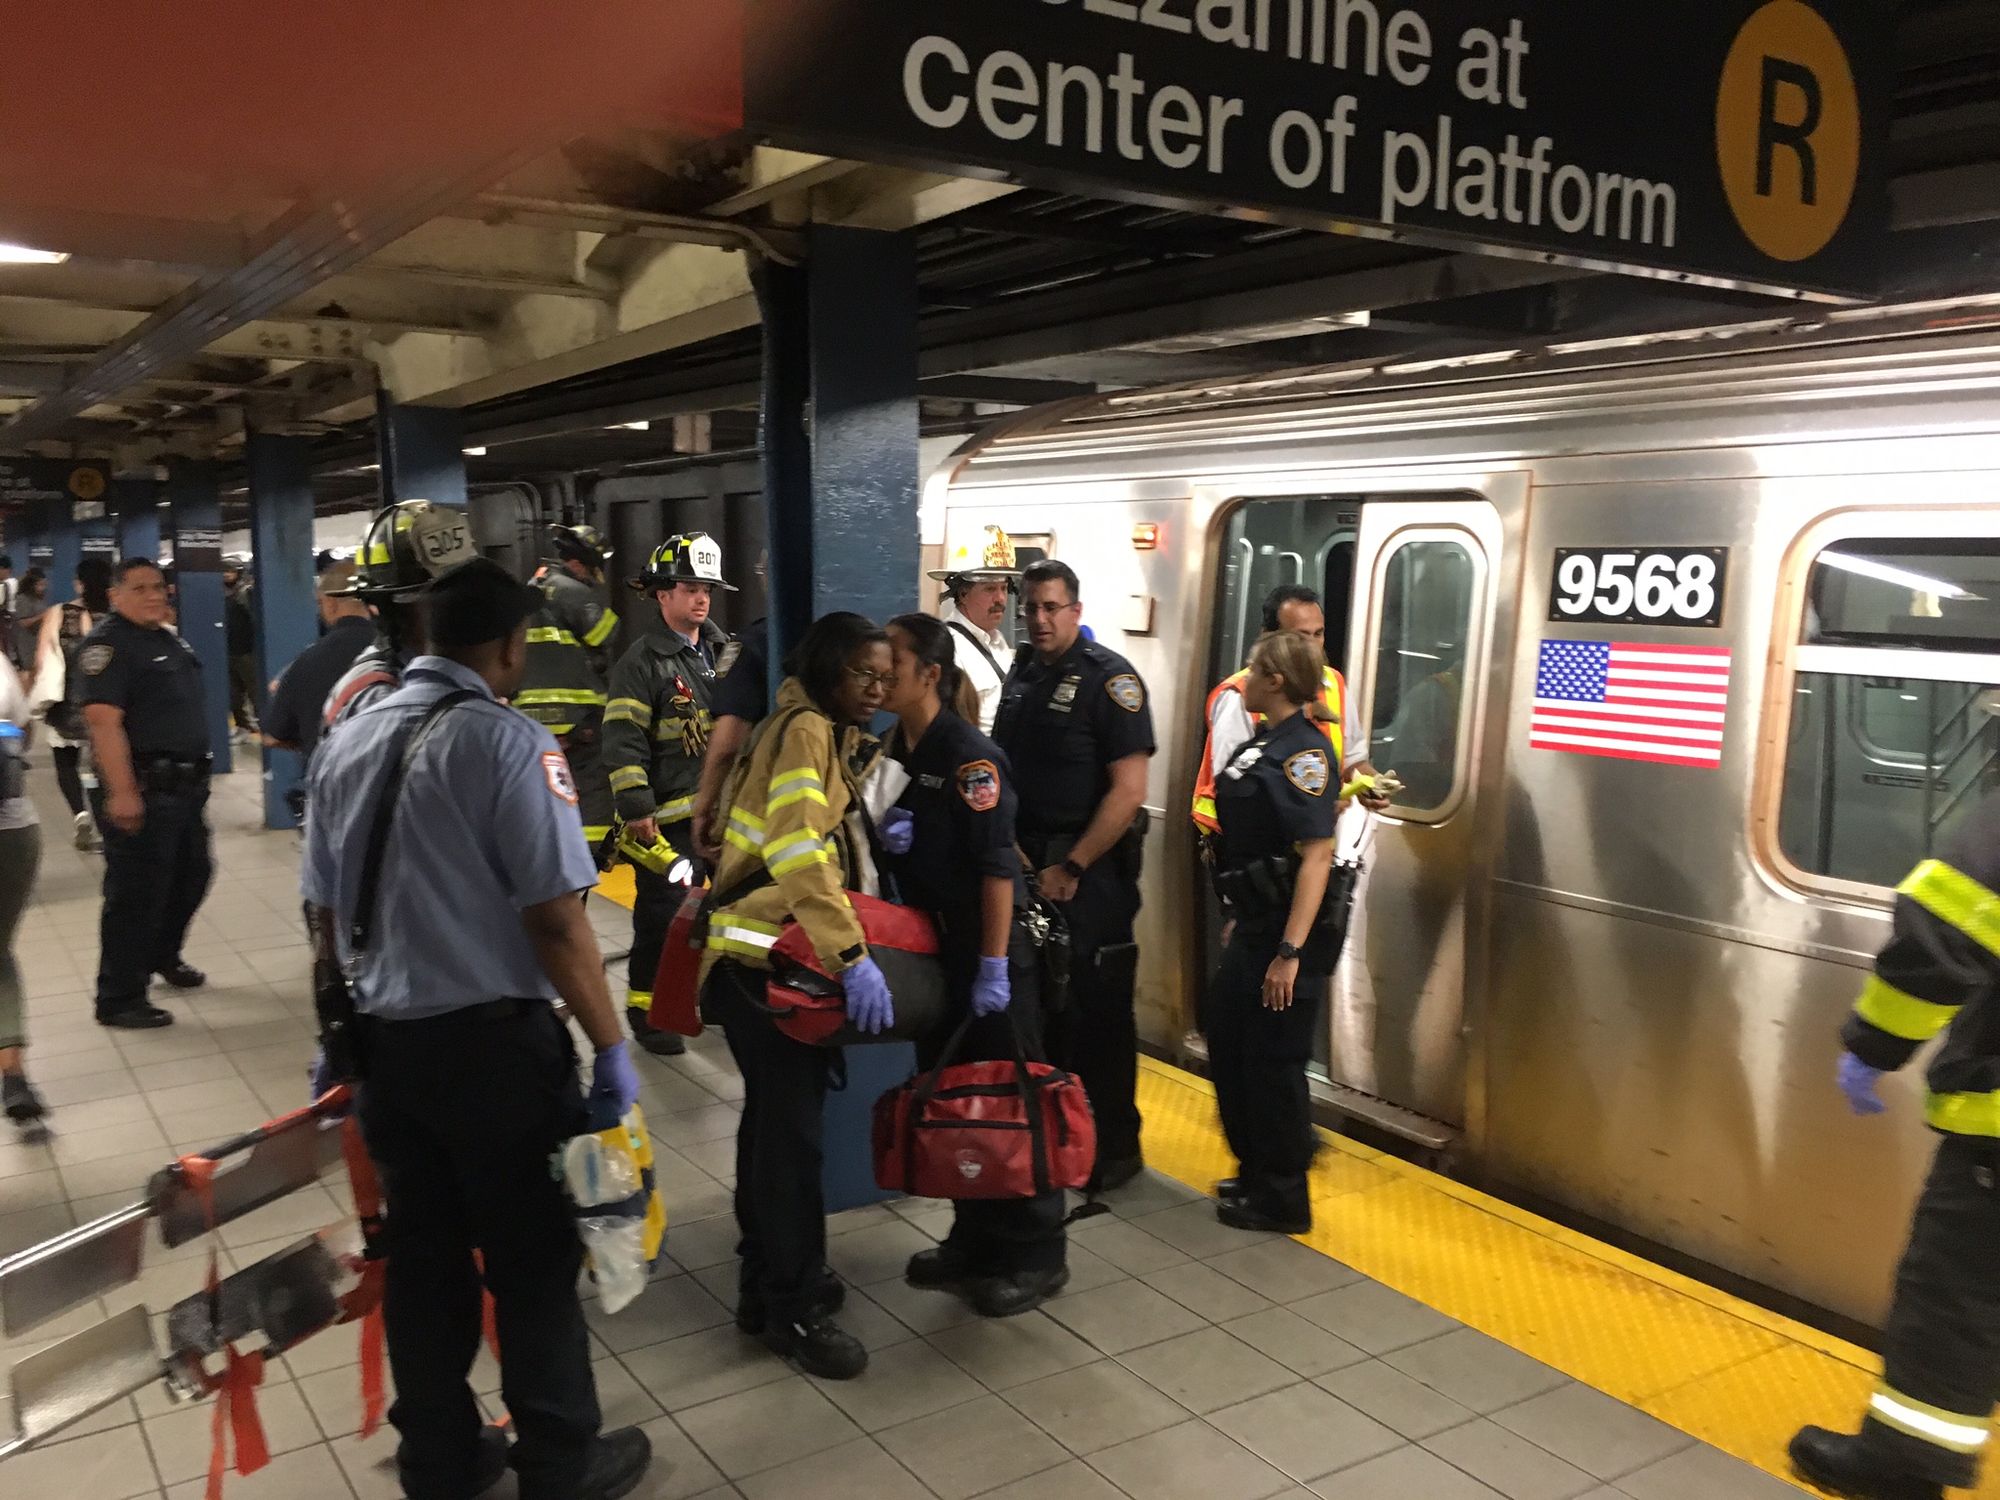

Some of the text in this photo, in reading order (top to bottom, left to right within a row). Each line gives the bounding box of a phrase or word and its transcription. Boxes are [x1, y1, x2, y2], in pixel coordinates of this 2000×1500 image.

[1457, 19, 1529, 109] at
[903, 35, 1676, 247] center of platform
[1756, 55, 1821, 206] R
[698, 551, 716, 566] 207
[1556, 554, 1716, 619] 9568
